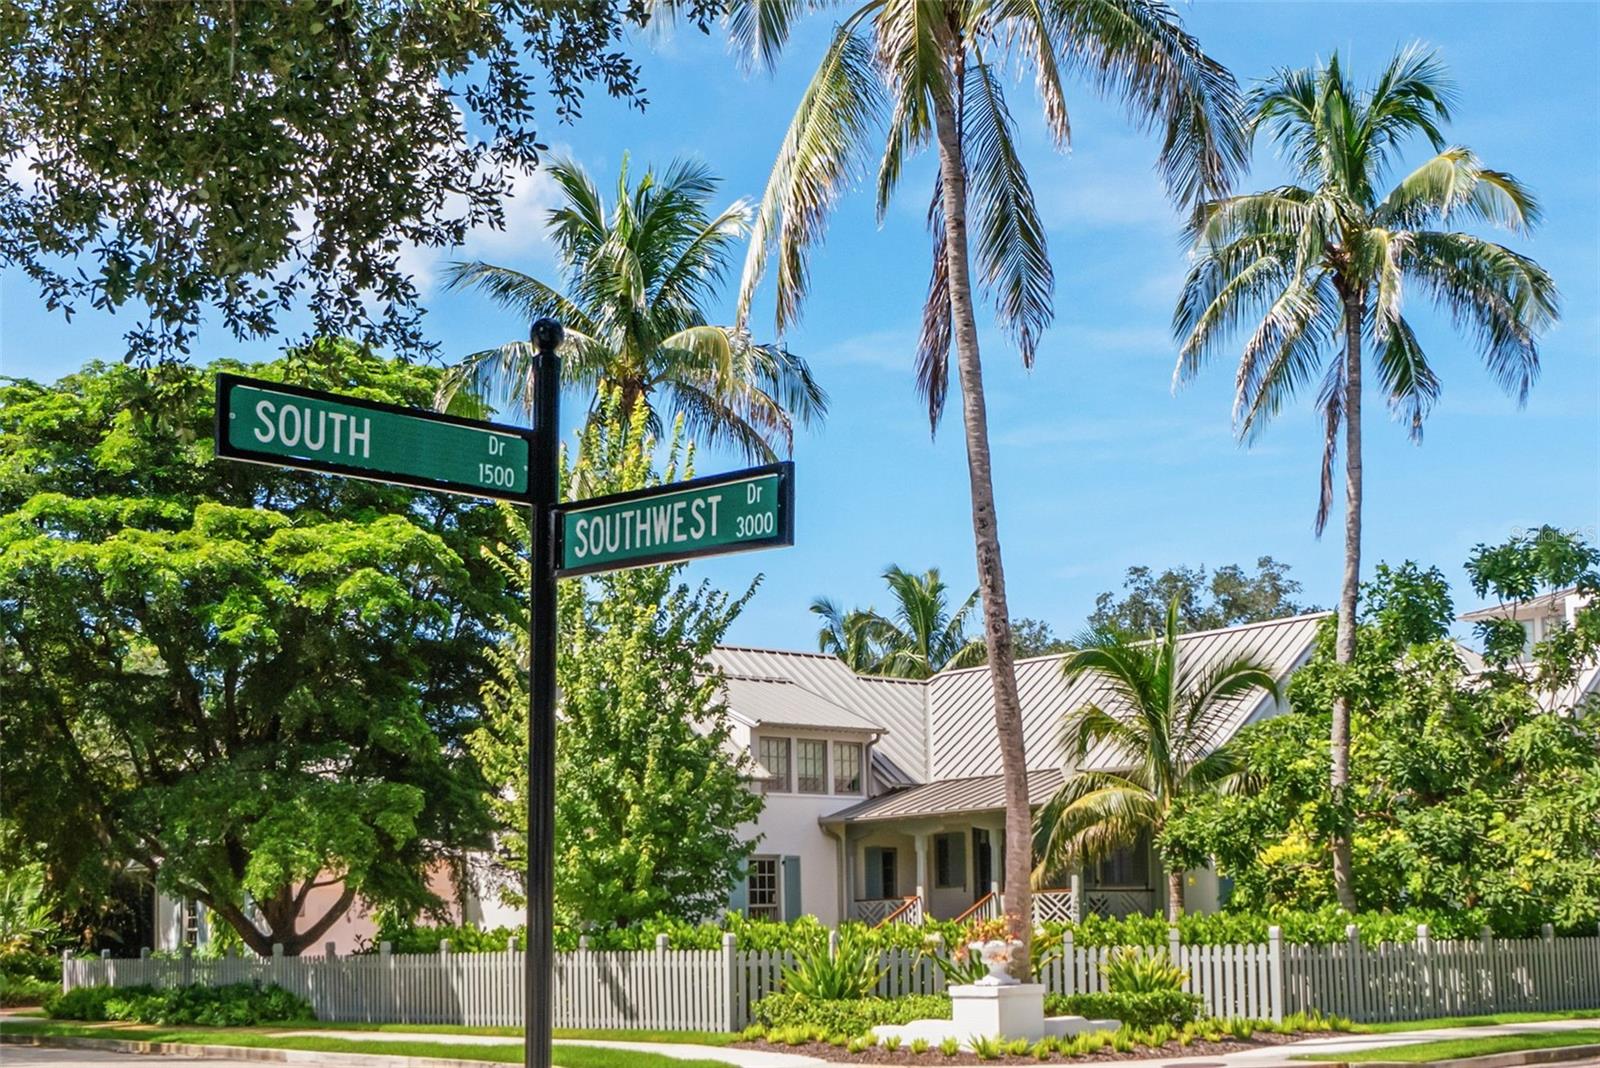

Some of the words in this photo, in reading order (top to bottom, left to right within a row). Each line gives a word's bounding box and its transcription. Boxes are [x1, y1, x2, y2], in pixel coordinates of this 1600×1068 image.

[254, 400, 371, 458] SOUTH
[488, 435, 505, 456] Dr
[478, 463, 515, 487] 1500
[747, 483, 763, 504] Dr
[574, 495, 722, 558] SOUTHWEST
[735, 511, 774, 538] 3000
